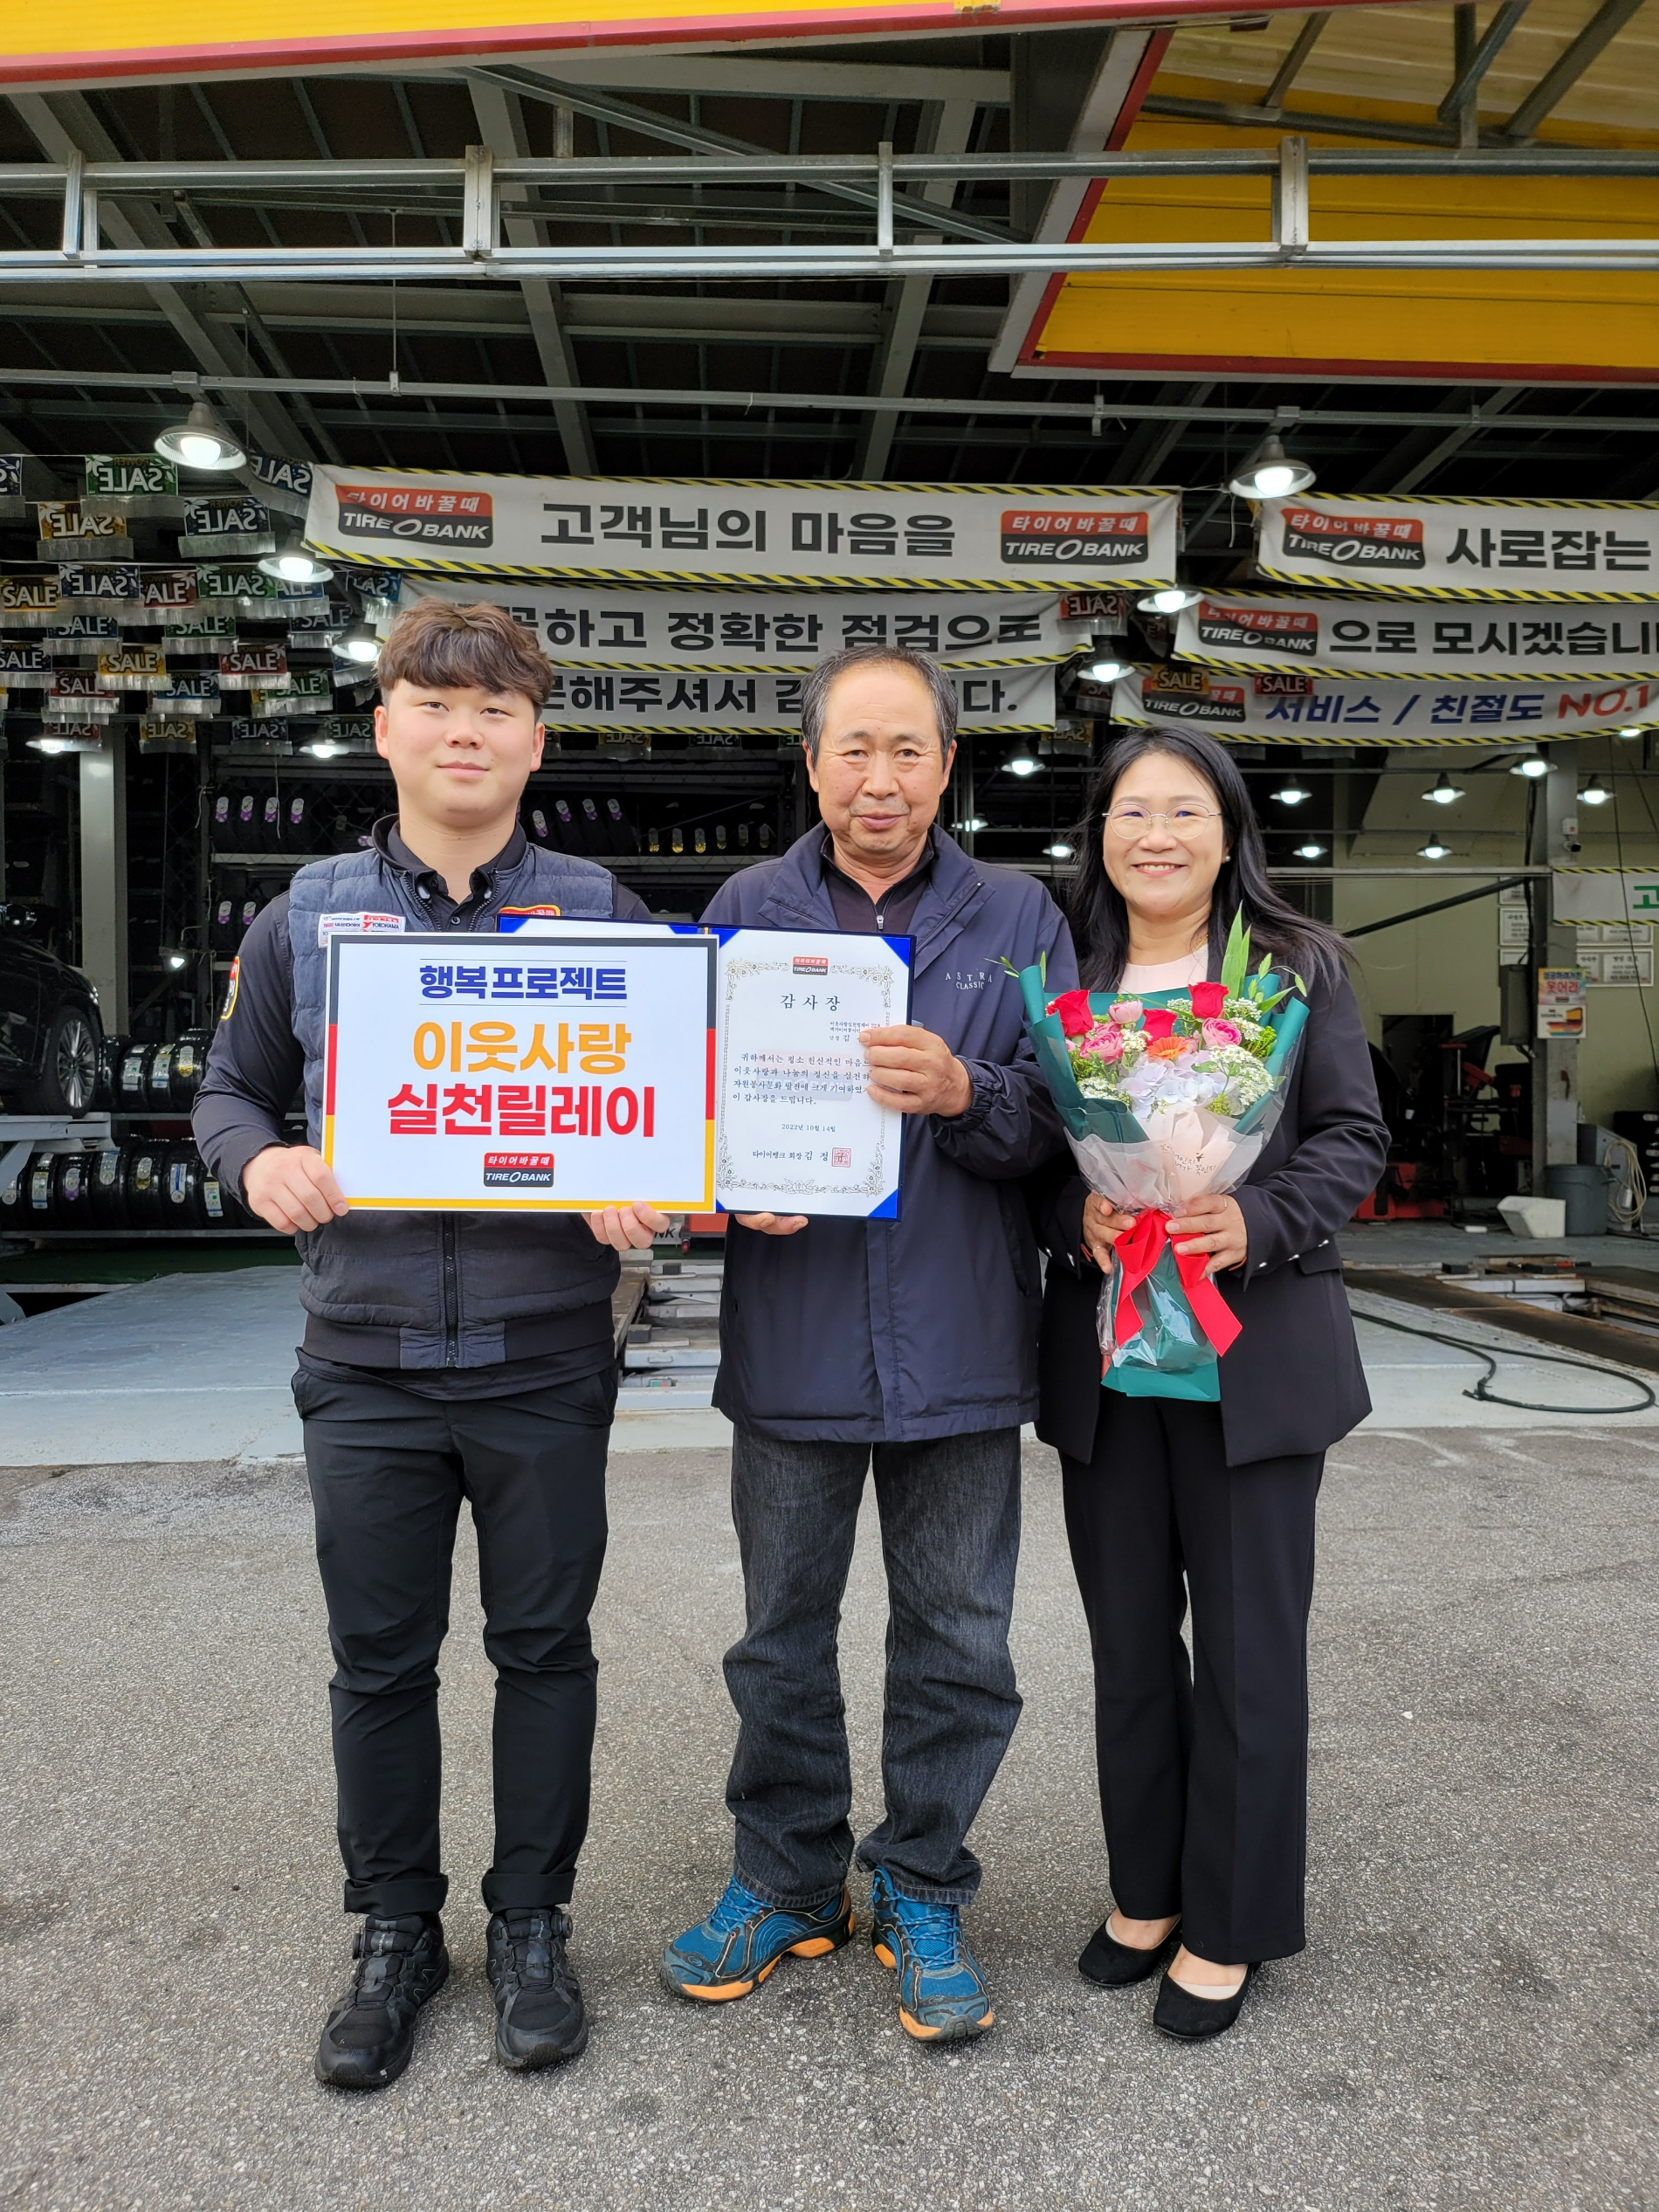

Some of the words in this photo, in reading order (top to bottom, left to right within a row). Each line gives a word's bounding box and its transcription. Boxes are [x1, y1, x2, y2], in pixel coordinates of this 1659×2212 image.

[541, 503, 766, 552] 고객님의
[792, 513, 954, 557] 마음을
[1012, 515, 1138, 533] 타이어바꿀때
[1291, 513, 1413, 540] 타이어바꿀때
[1446, 527, 1651, 571] 사로잡는
[3, 586, 57, 607] SALE
[278, 582, 313, 596] ALE
[489, 605, 647, 648] 하고
[668, 612, 823, 652] 정확한
[842, 614, 1042, 652] 점검으로
[1330, 620, 1417, 653] 으로
[1433, 621, 1659, 656] 모시겠습니
[108, 653, 157, 672] SALE
[231, 653, 278, 672] SALE
[1159, 671, 1201, 690] SALE
[1263, 676, 1305, 693] SALE
[1265, 695, 1382, 724] 서비스
[1430, 694, 1545, 724] 친절도
[1558, 685, 1649, 719] NO.1
[945, 972, 993, 982] ASTRA
[956, 981, 985, 990] CLASSIC
[413, 1021, 632, 1074] 이웃사랑
[741, 1053, 784, 1064] 귀하께서는
[787, 1055, 804, 1064] 평소
[808, 1056, 842, 1067] 헌신적인
[845, 1058, 871, 1067] 마음으
[733, 1066, 779, 1077] 이웃사랑과
[783, 1068, 809, 1078] 나눔의
[813, 1070, 840, 1080] 정신을
[843, 1072, 871, 1081] 실천하
[733, 1079, 782, 1091] 자원봉사문화
[785, 1081, 809, 1092] 발전에
[811, 1084, 827, 1092] 크게
[733, 1092, 740, 1102] 이
[744, 1093, 777, 1104] 감사장을
[780, 1095, 816, 1106] 드립니다.
[388, 1083, 655, 1137] 실천릴레이
[488, 1155, 550, 1166] 타이어바꿀때
[752, 1150, 787, 1160] 타이어뱅크
[788, 1152, 802, 1161] 회장
